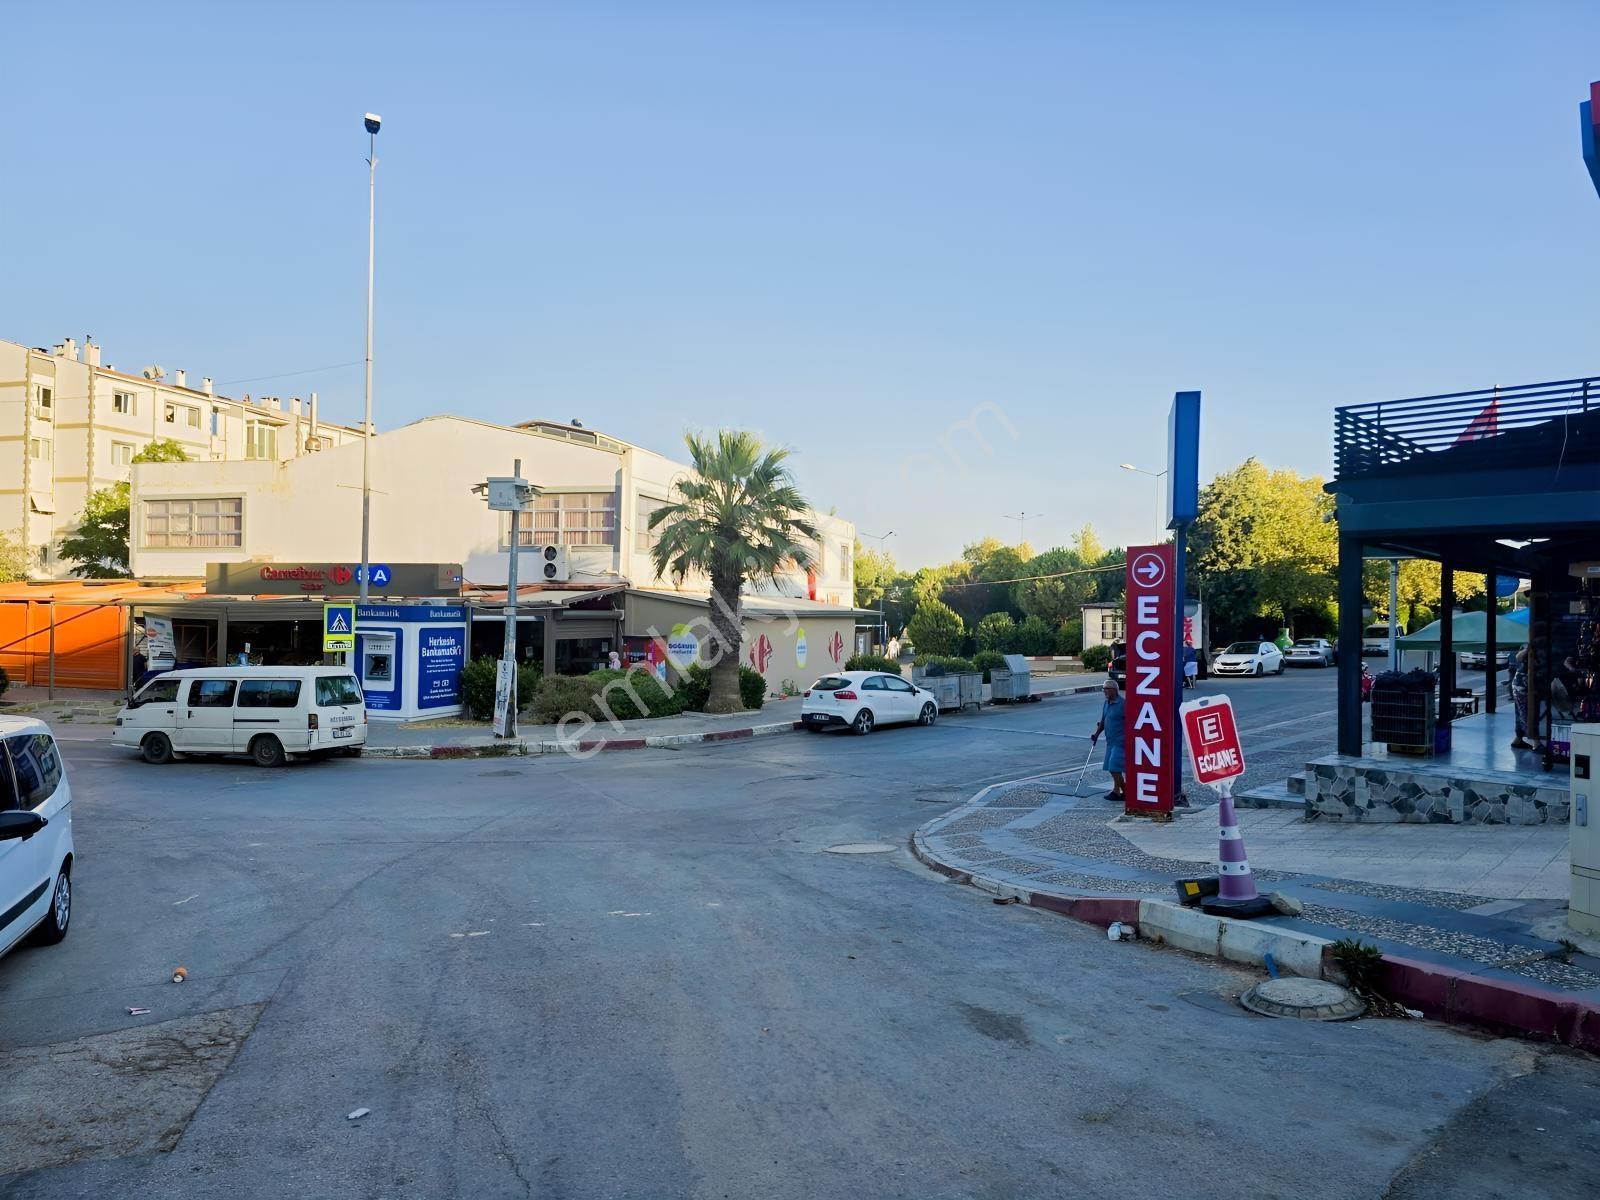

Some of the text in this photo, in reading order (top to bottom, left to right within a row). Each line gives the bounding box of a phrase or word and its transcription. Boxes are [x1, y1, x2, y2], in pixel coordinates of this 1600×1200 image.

[357, 608, 400, 618] Bankamatik
[429, 610, 462, 618] Bankamatik
[429, 636, 456, 646] Herkesin
[1134, 595, 1162, 803] ECZANE
[1202, 717, 1220, 741] E
[1197, 747, 1239, 775] ECZANE
